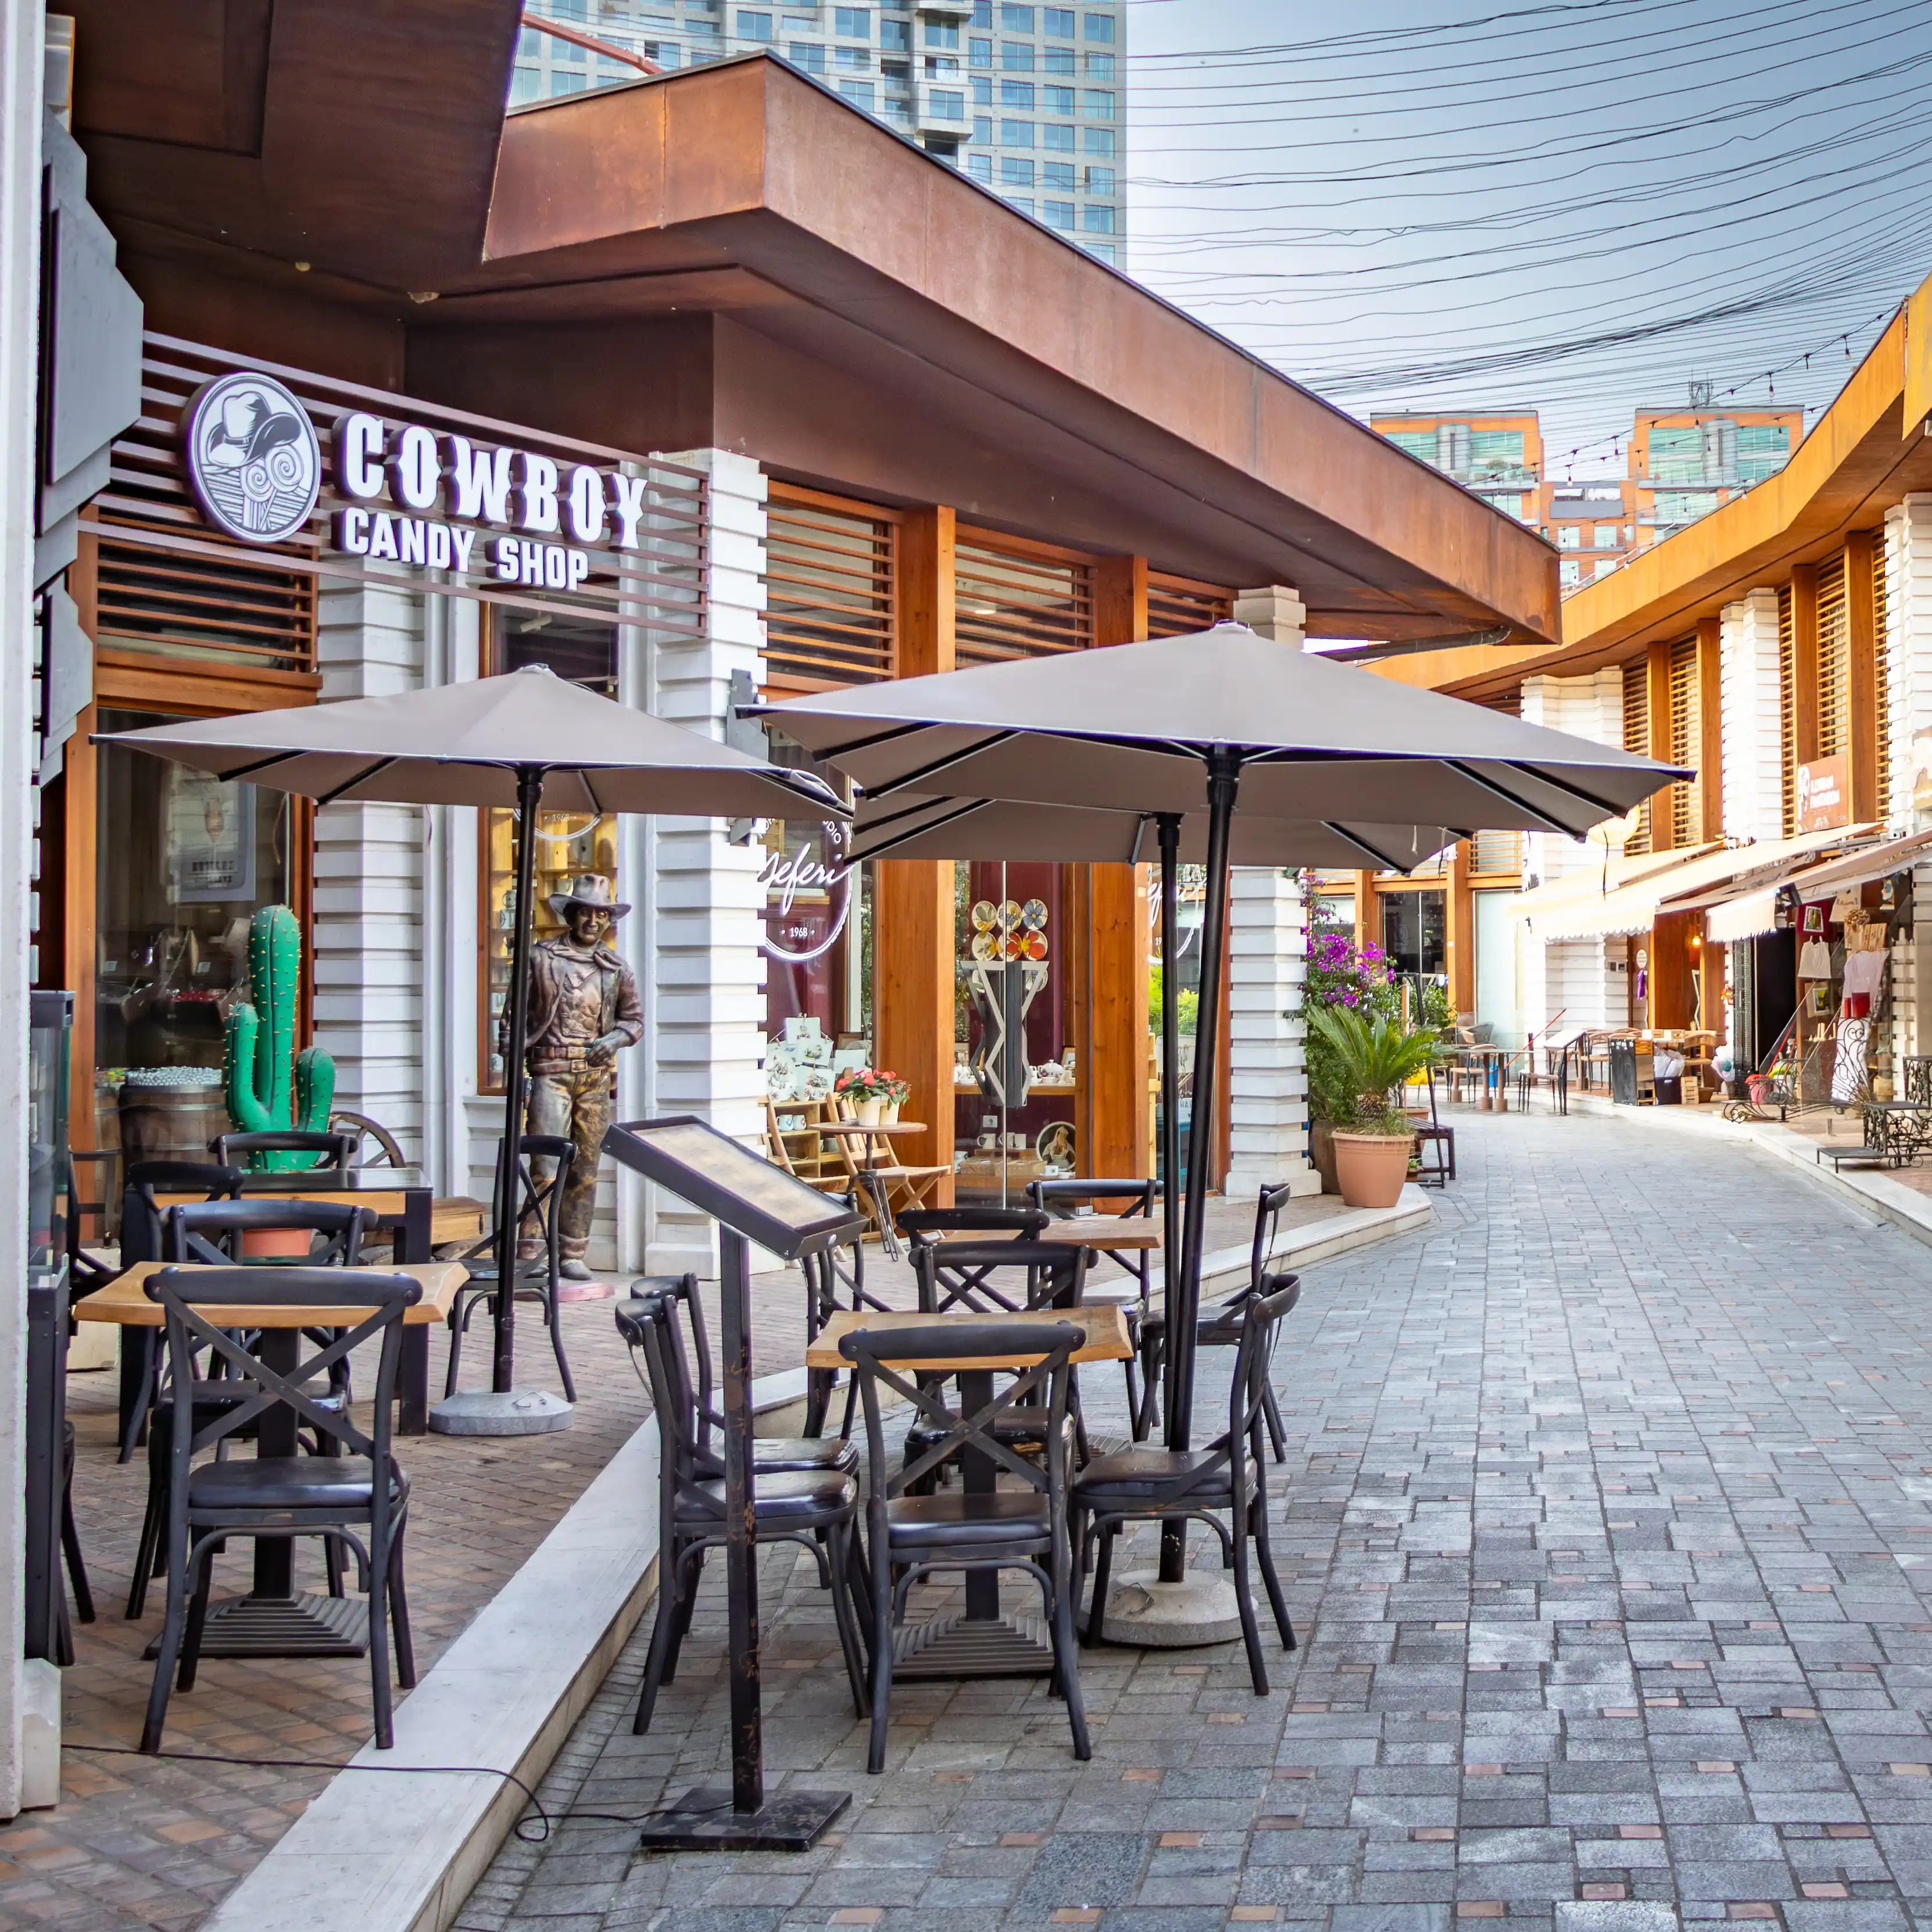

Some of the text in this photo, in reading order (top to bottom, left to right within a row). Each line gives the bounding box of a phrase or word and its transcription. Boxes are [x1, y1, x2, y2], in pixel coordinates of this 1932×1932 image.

[345, 413, 649, 549] COWBOY
[344, 506, 589, 592] CANDY SHOP
[790, 927, 808, 937] 1968
